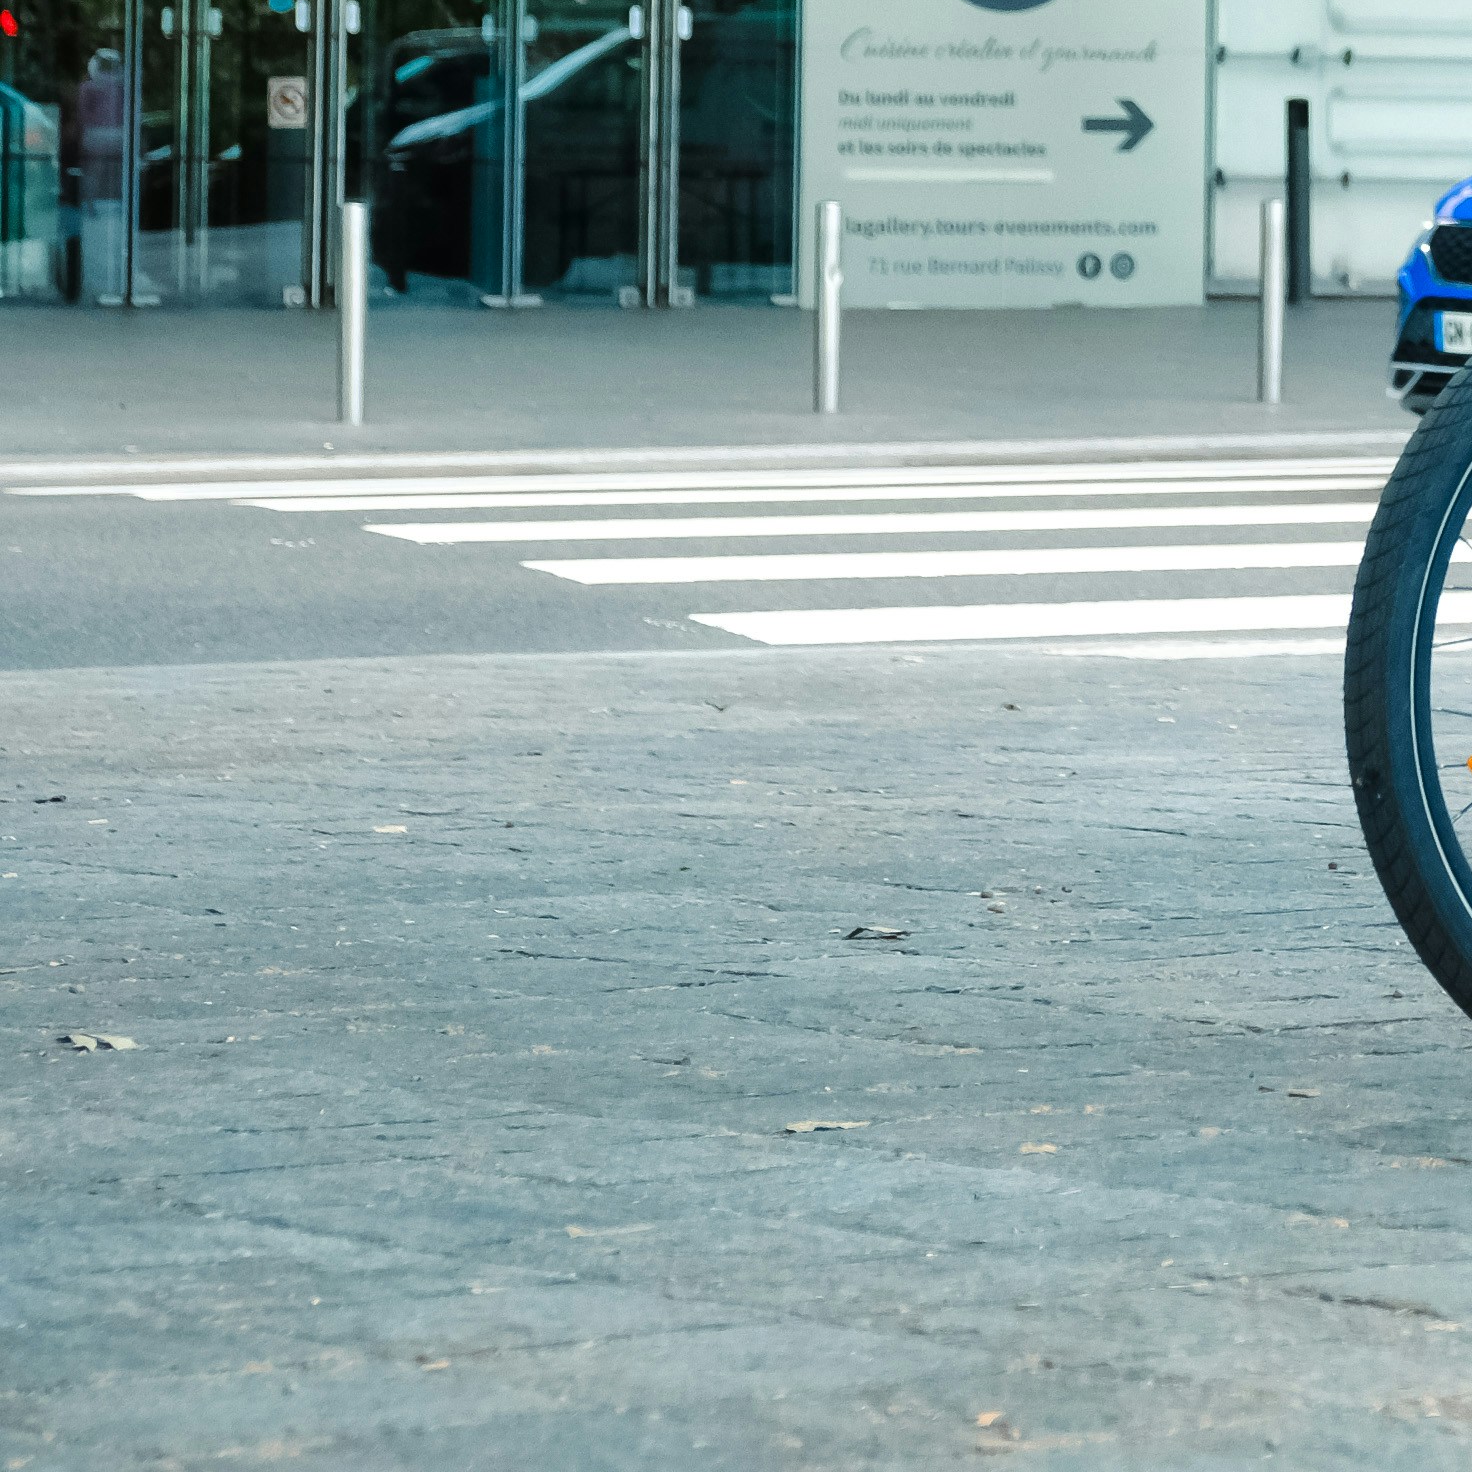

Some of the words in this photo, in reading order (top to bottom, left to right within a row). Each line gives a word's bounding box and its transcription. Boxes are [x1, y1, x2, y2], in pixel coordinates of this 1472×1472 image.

[838, 90, 860, 106] Du
[865, 89, 910, 107] lundi
[915, 91, 935, 107] au
[939, 90, 1016, 108] vendredi
[932, 140, 953, 156] de
